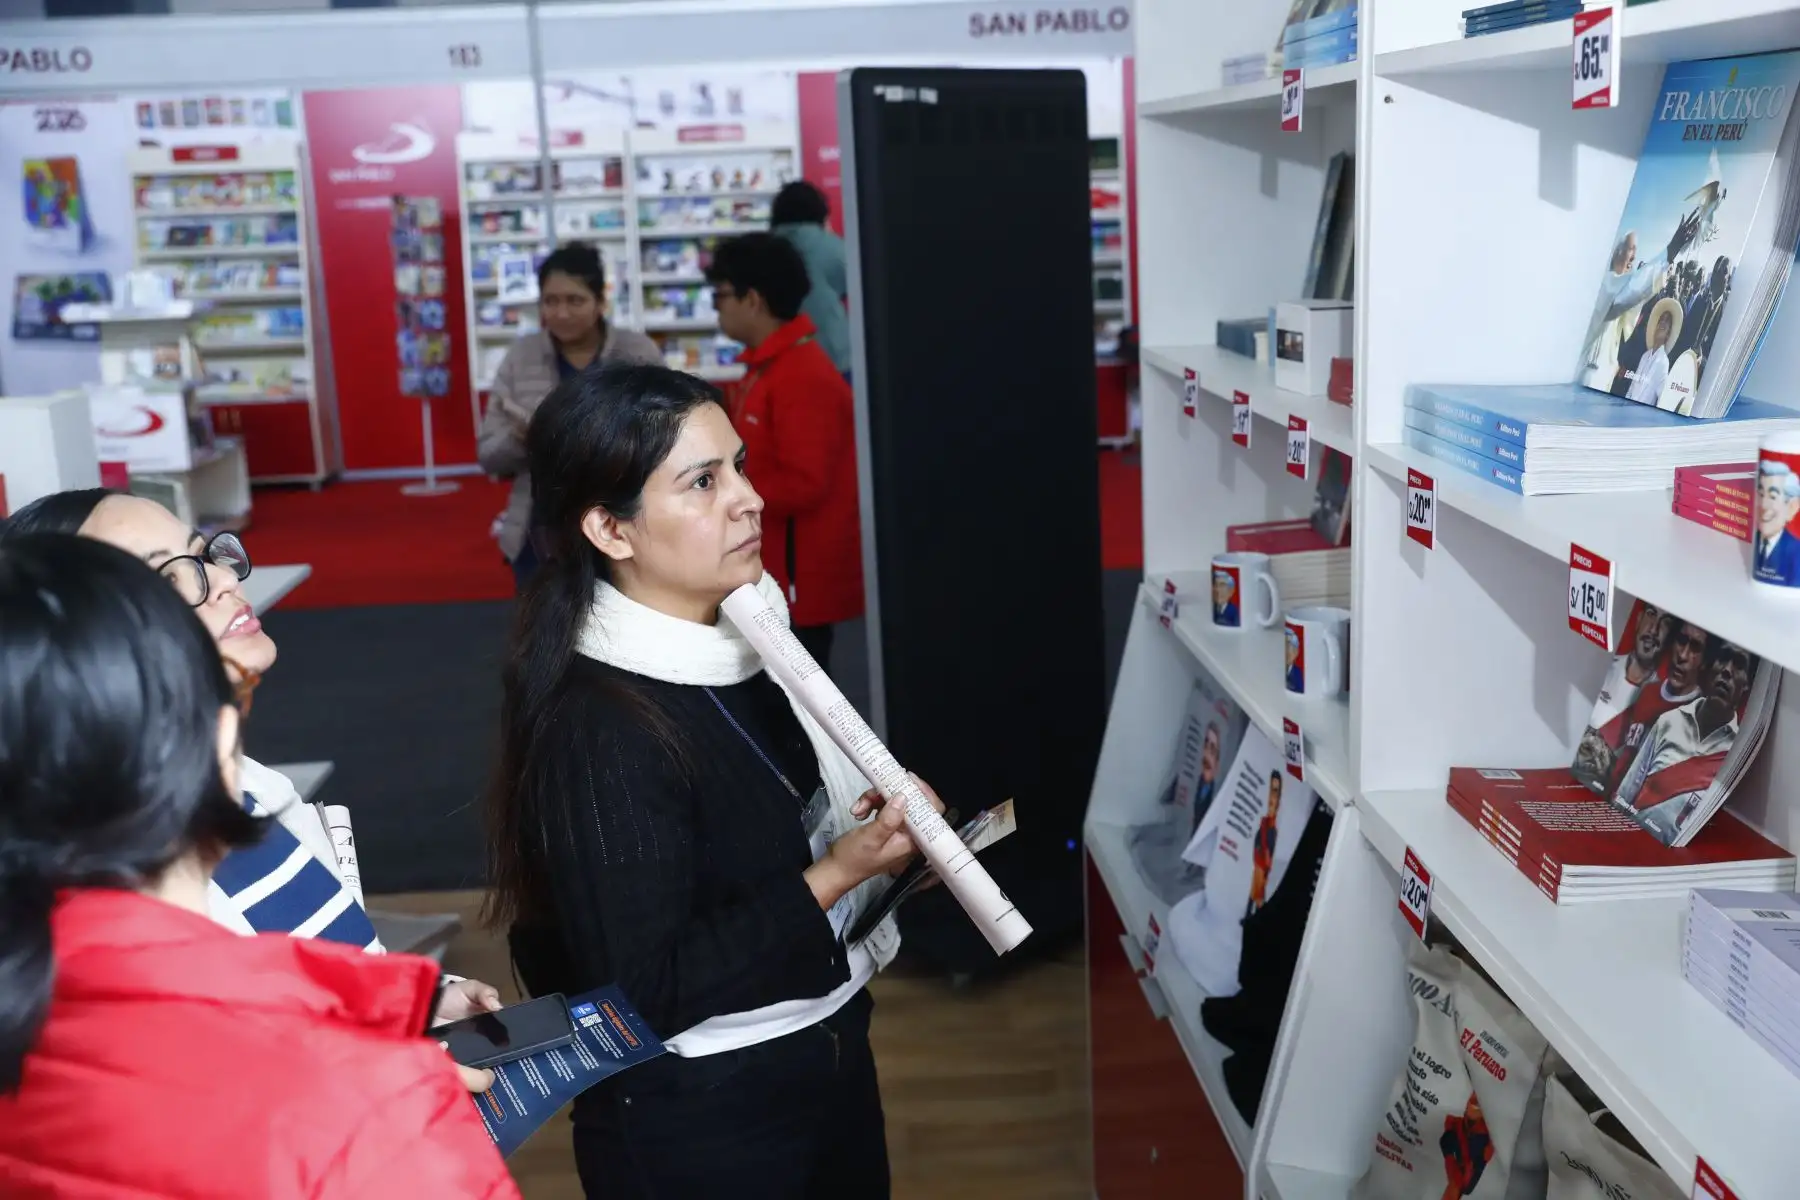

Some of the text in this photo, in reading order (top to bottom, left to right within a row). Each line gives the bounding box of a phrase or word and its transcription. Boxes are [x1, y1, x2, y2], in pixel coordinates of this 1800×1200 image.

[969, 7, 1130, 38] SAN PABLO
[1659, 85, 1787, 121] FRANCISCO
[1682, 118, 1748, 141] EN EL PERÚ
[1573, 552, 1592, 569] PRECIO
[1570, 586, 1580, 609] S/
[1581, 623, 1606, 644] ESPECIAL
[1460, 1028, 1507, 1082] El Peruano
[1425, 1056, 1452, 1079] logro
[1420, 1089, 1440, 1106] sido
